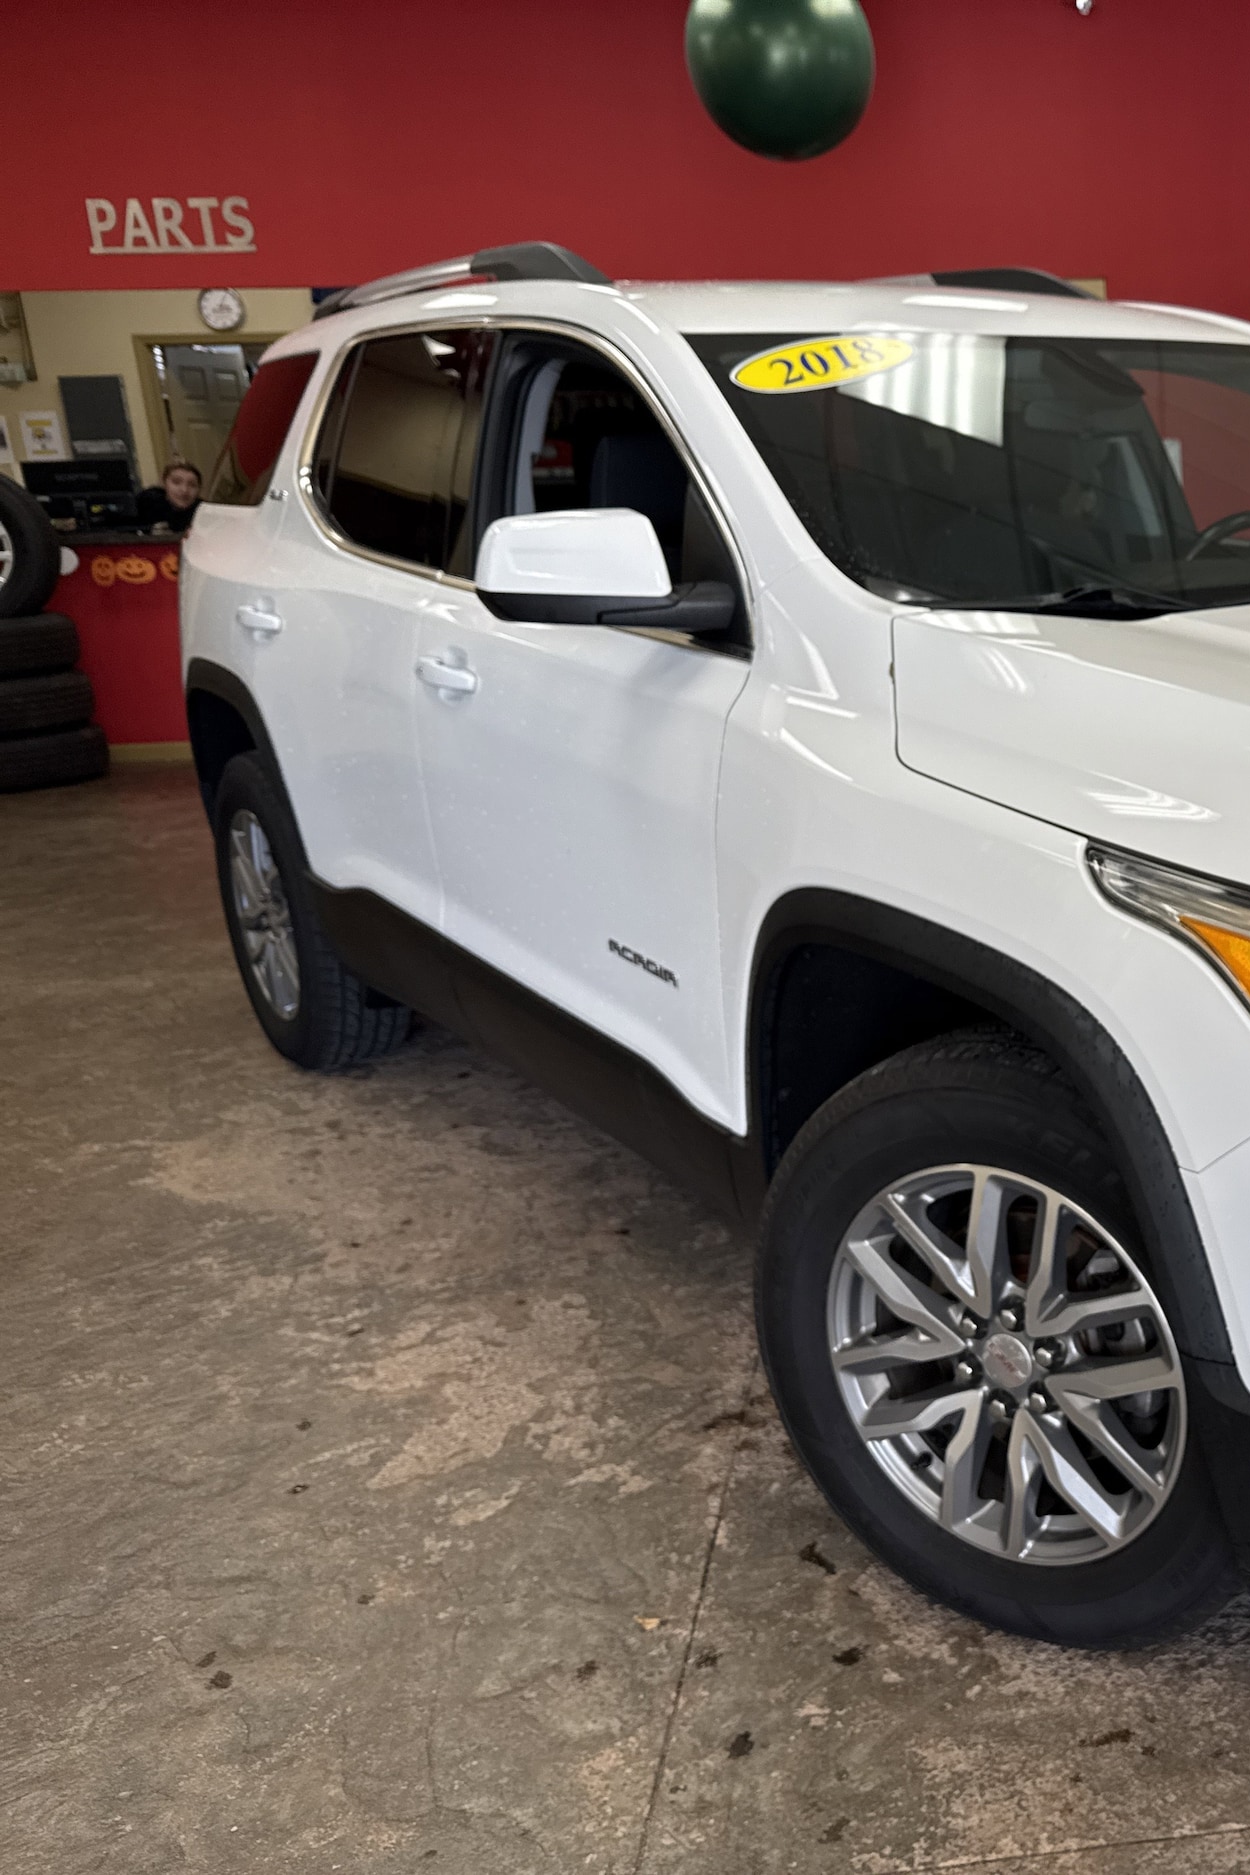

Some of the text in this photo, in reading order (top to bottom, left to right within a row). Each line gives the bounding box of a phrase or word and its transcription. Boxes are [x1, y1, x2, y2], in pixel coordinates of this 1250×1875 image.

[85, 196, 257, 252] PARTS
[769, 338, 885, 386] 2018
[607, 938, 679, 988] ACADIA
